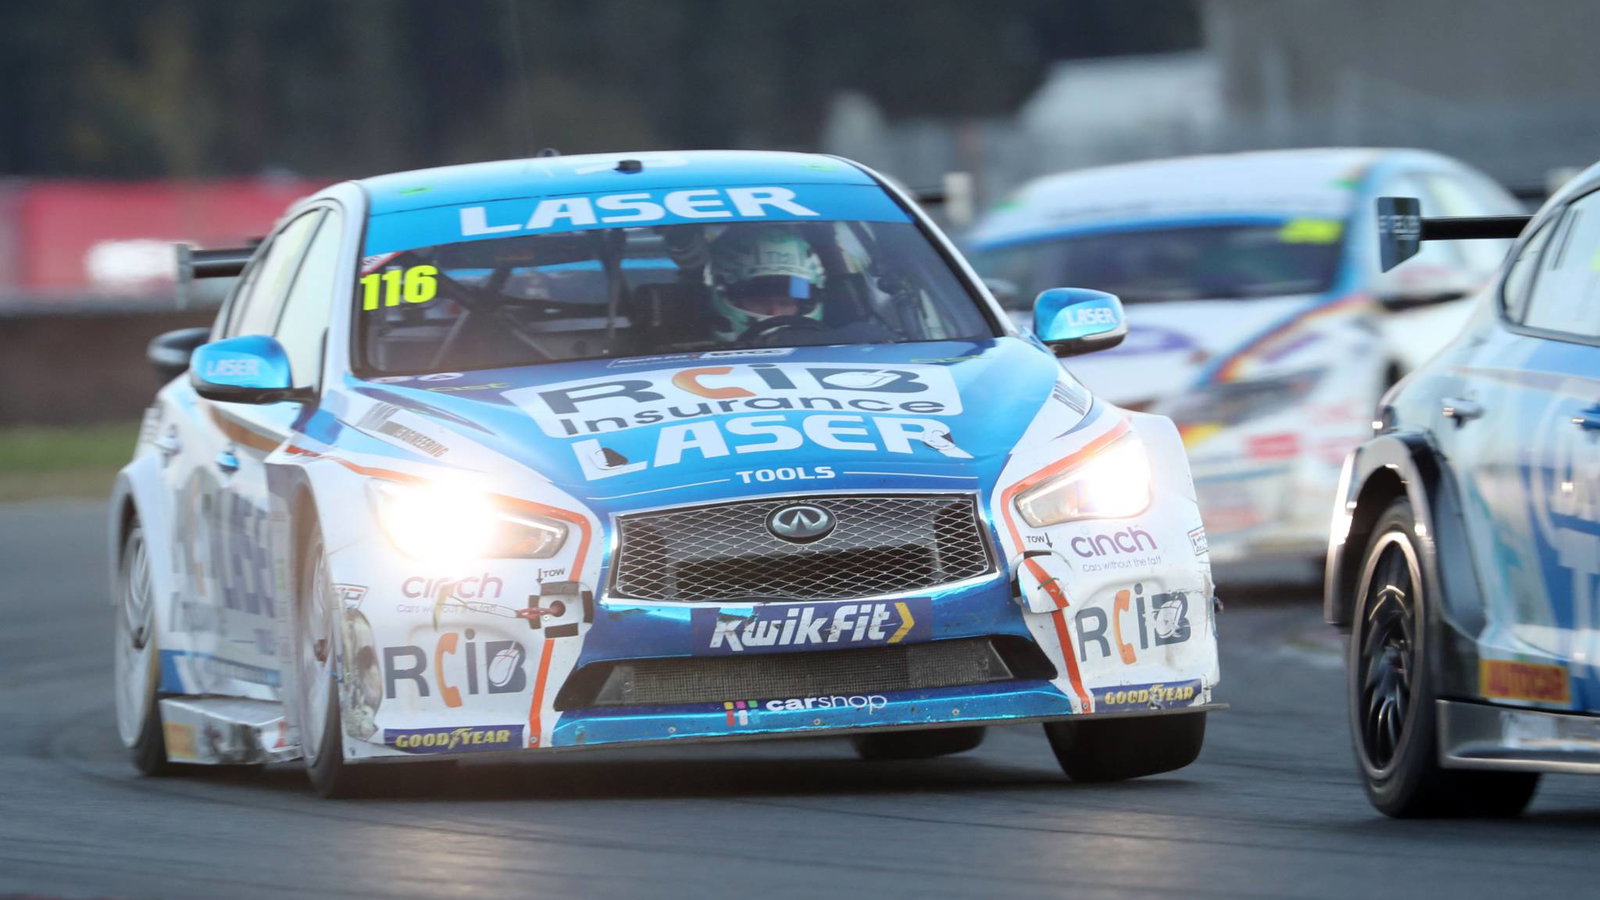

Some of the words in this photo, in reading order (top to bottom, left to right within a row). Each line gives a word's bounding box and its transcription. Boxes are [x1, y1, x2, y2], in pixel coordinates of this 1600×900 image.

[460, 187, 820, 237] LASER
[360, 265, 439, 311] 116
[1065, 307, 1118, 326] LASER
[205, 358, 259, 377] LASER
[570, 414, 974, 482] LASER
[735, 466, 836, 485] TOOLS
[1026, 535, 1045, 544] TOW
[1070, 526, 1158, 558] cinch
[543, 568, 566, 578] TOW
[709, 606, 829, 652] Kwik
[765, 695, 888, 715] carshop
[1104, 684, 1195, 707] GOODYEAR
[394, 728, 511, 749] GOODYEAR
